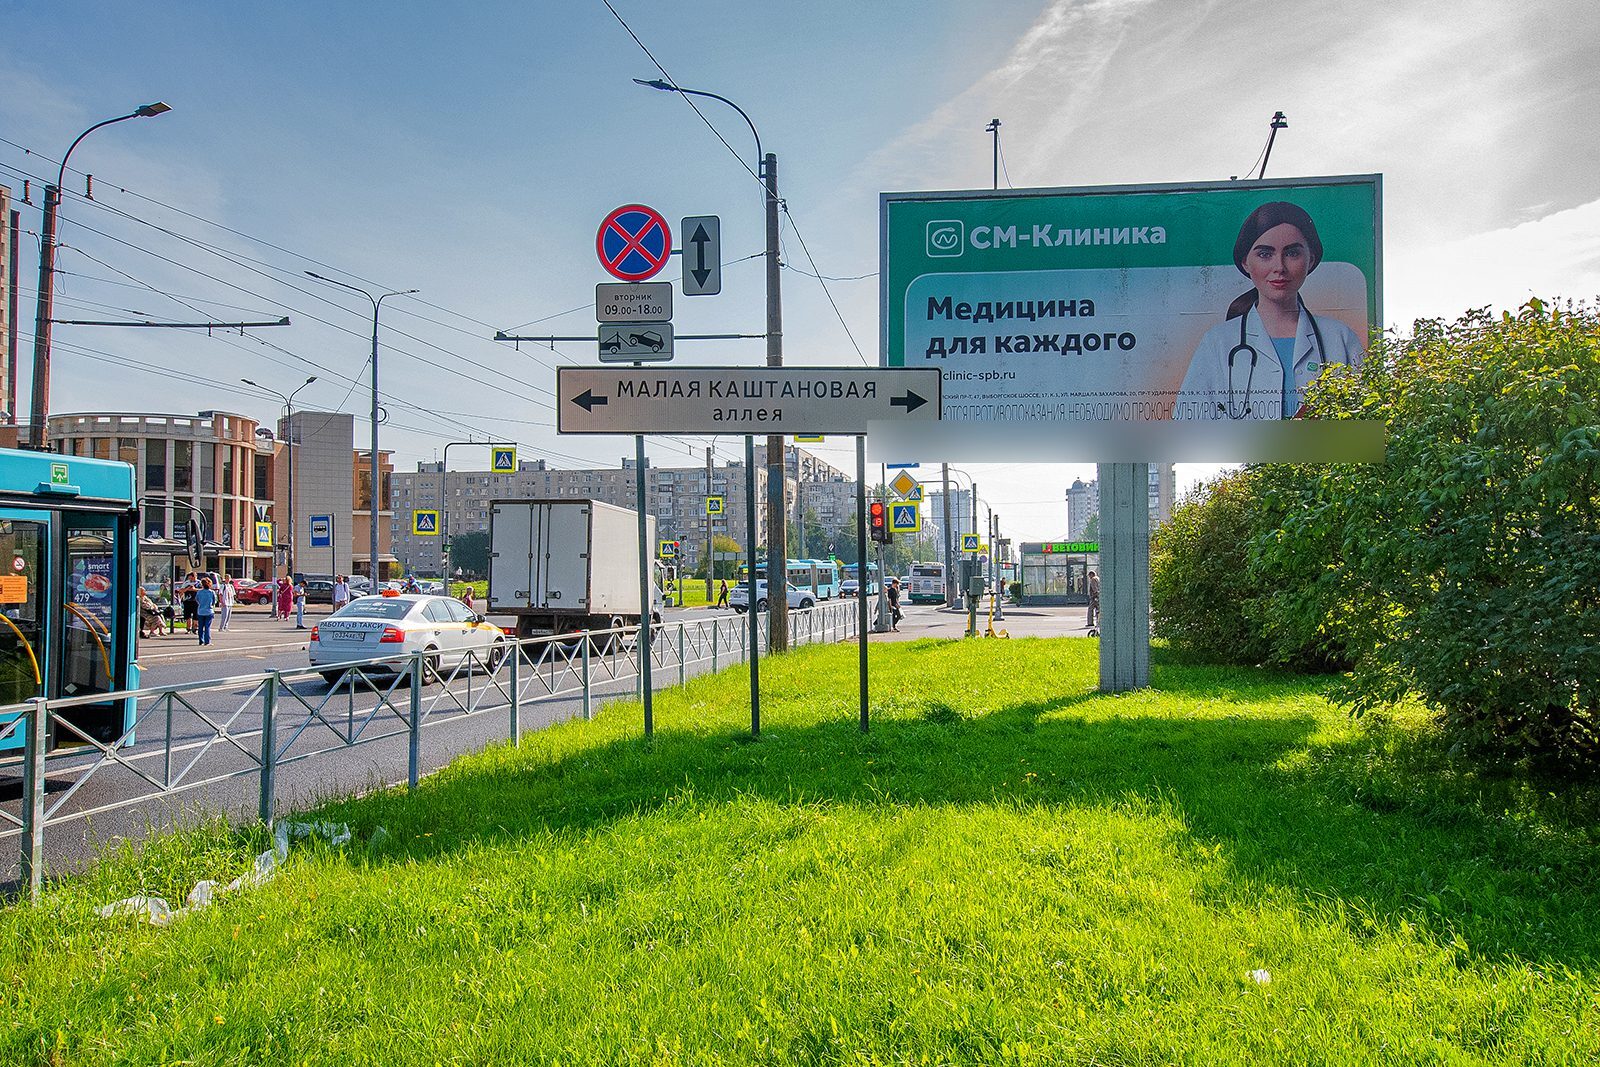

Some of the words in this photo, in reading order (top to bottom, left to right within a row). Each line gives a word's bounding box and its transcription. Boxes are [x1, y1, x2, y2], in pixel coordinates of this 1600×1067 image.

[970, 223, 1167, 250] СМ-Клиника
[614, 293, 652, 301] вторник
[604, 303, 663, 316] 09.00-18.00
[926, 294, 1096, 324] Медицина
[926, 334, 988, 359] для
[994, 330, 1137, 358] каждого
[617, 381, 701, 398] МАЛАЯ
[708, 380, 877, 399] КАШТАНОВАЯ
[712, 408, 783, 422] аллея
[1069, 402, 1131, 421] НЕОБХОДИМО
[74, 592, 90, 603] 479
